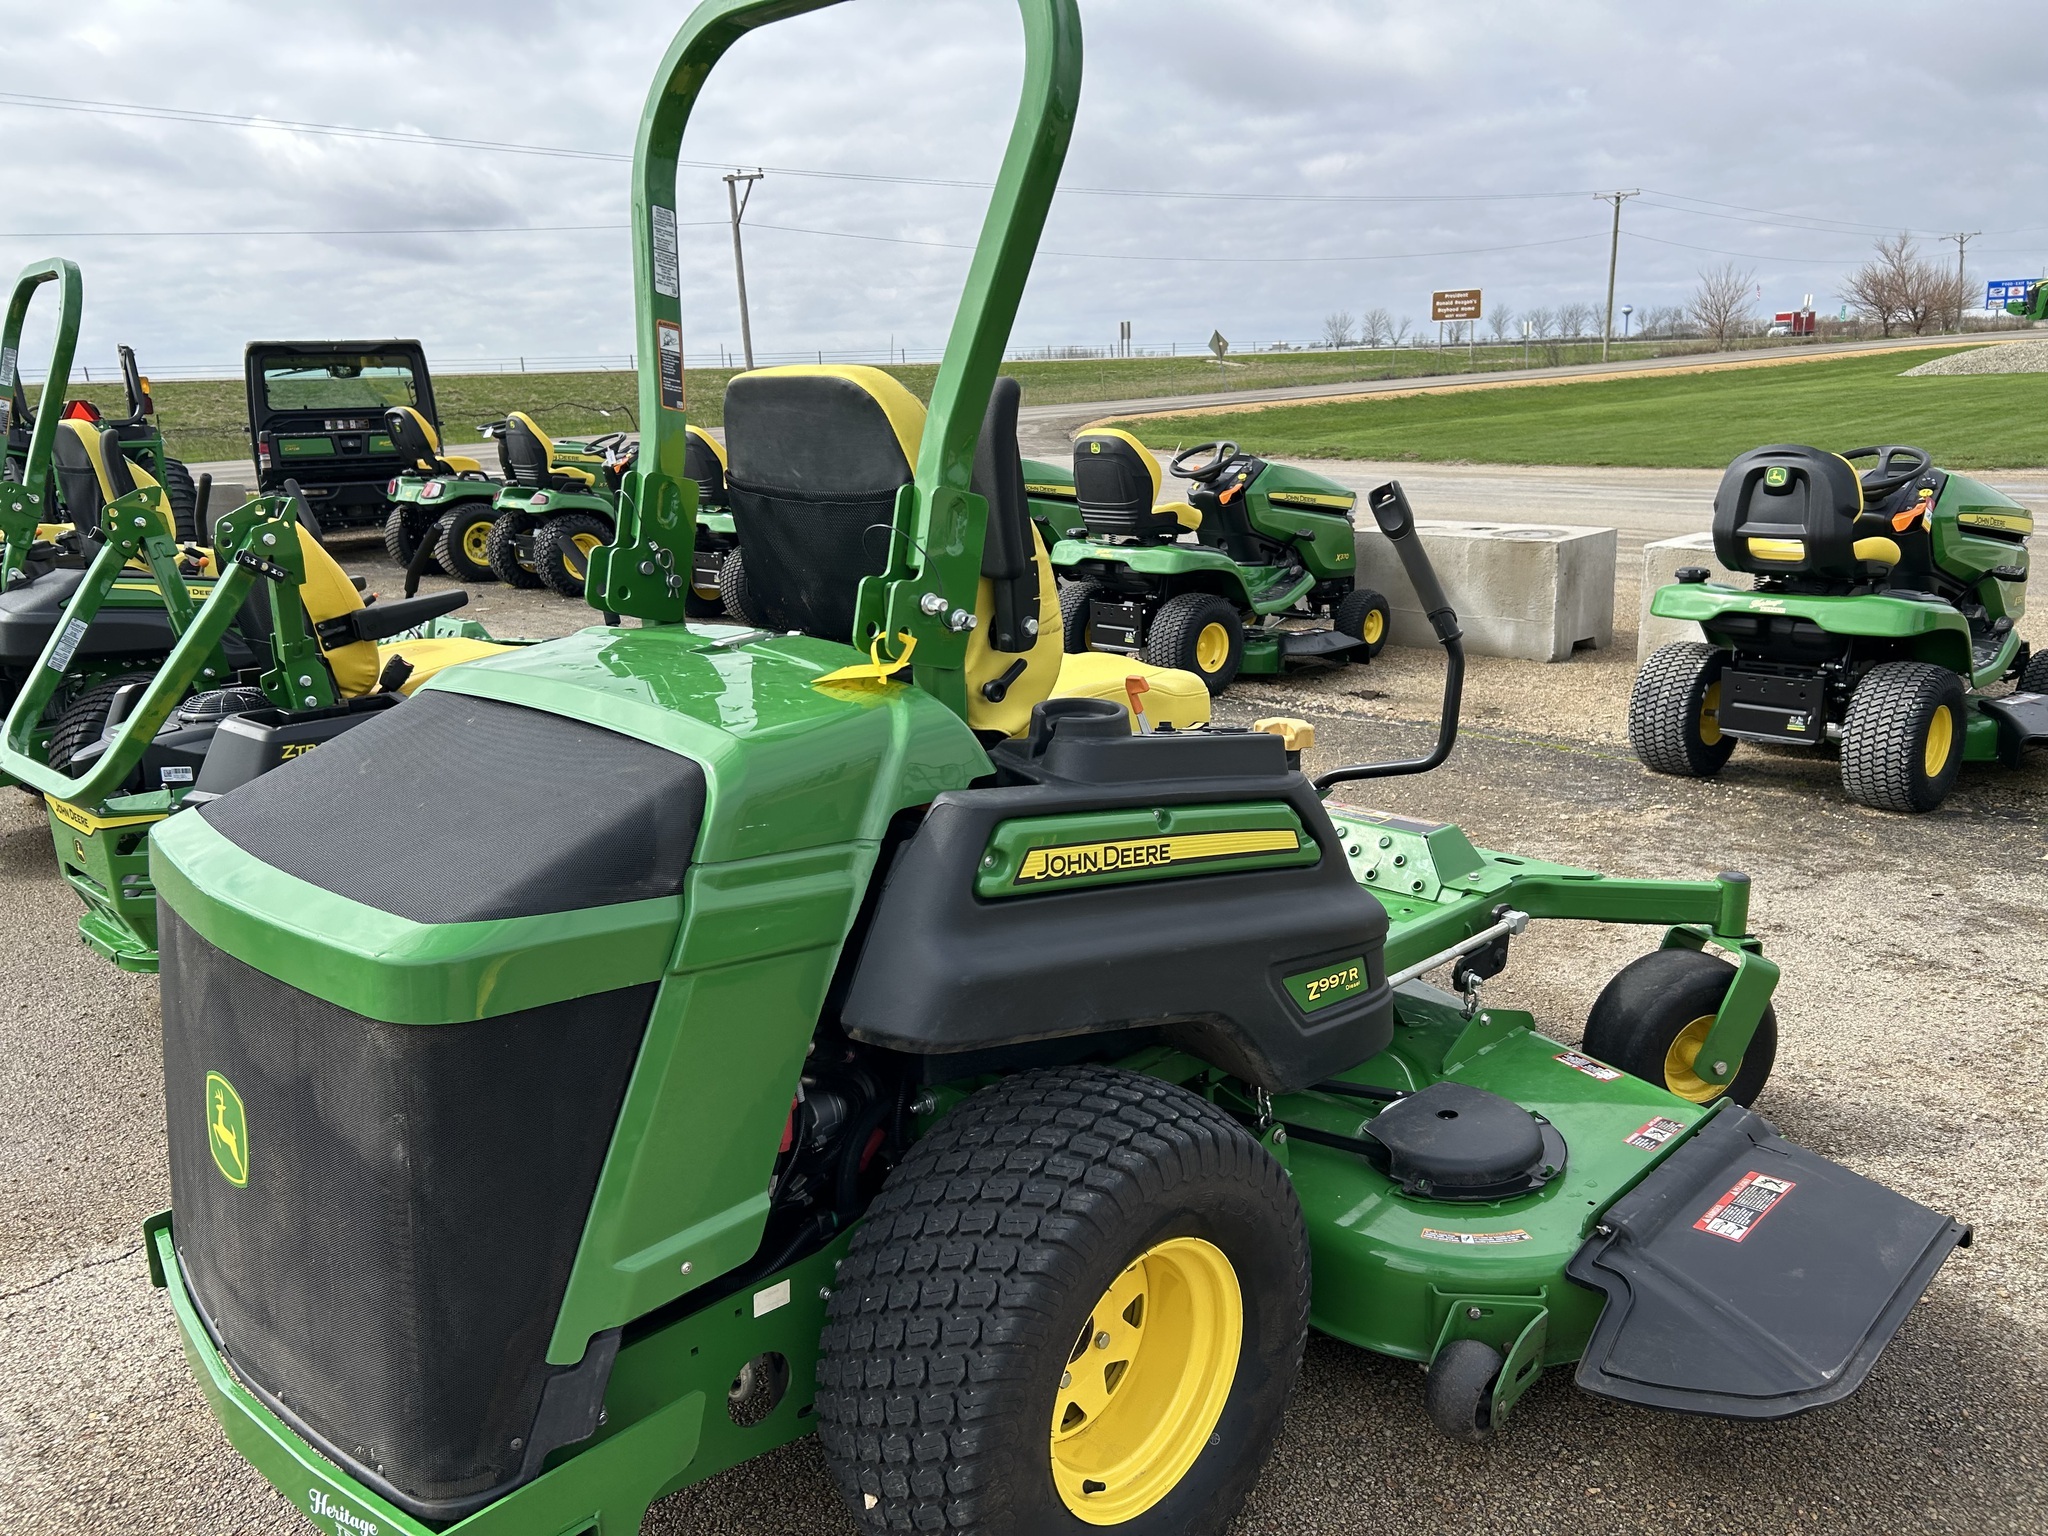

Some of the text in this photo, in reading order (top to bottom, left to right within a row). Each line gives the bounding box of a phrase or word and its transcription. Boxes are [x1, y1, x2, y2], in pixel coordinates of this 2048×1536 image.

[1040, 486, 1057, 494] DEERE
[1284, 493, 1317, 504] JOHN DEERE
[1974, 515, 2006, 528] JOHN DEERE
[192, 588, 213, 596] DEE
[55, 801, 90, 829] JOHN DEERE
[1036, 843, 1171, 877] JOHN DEERE
[1345, 980, 1361, 991] Diesel
[308, 1488, 379, 1536] Heritage
